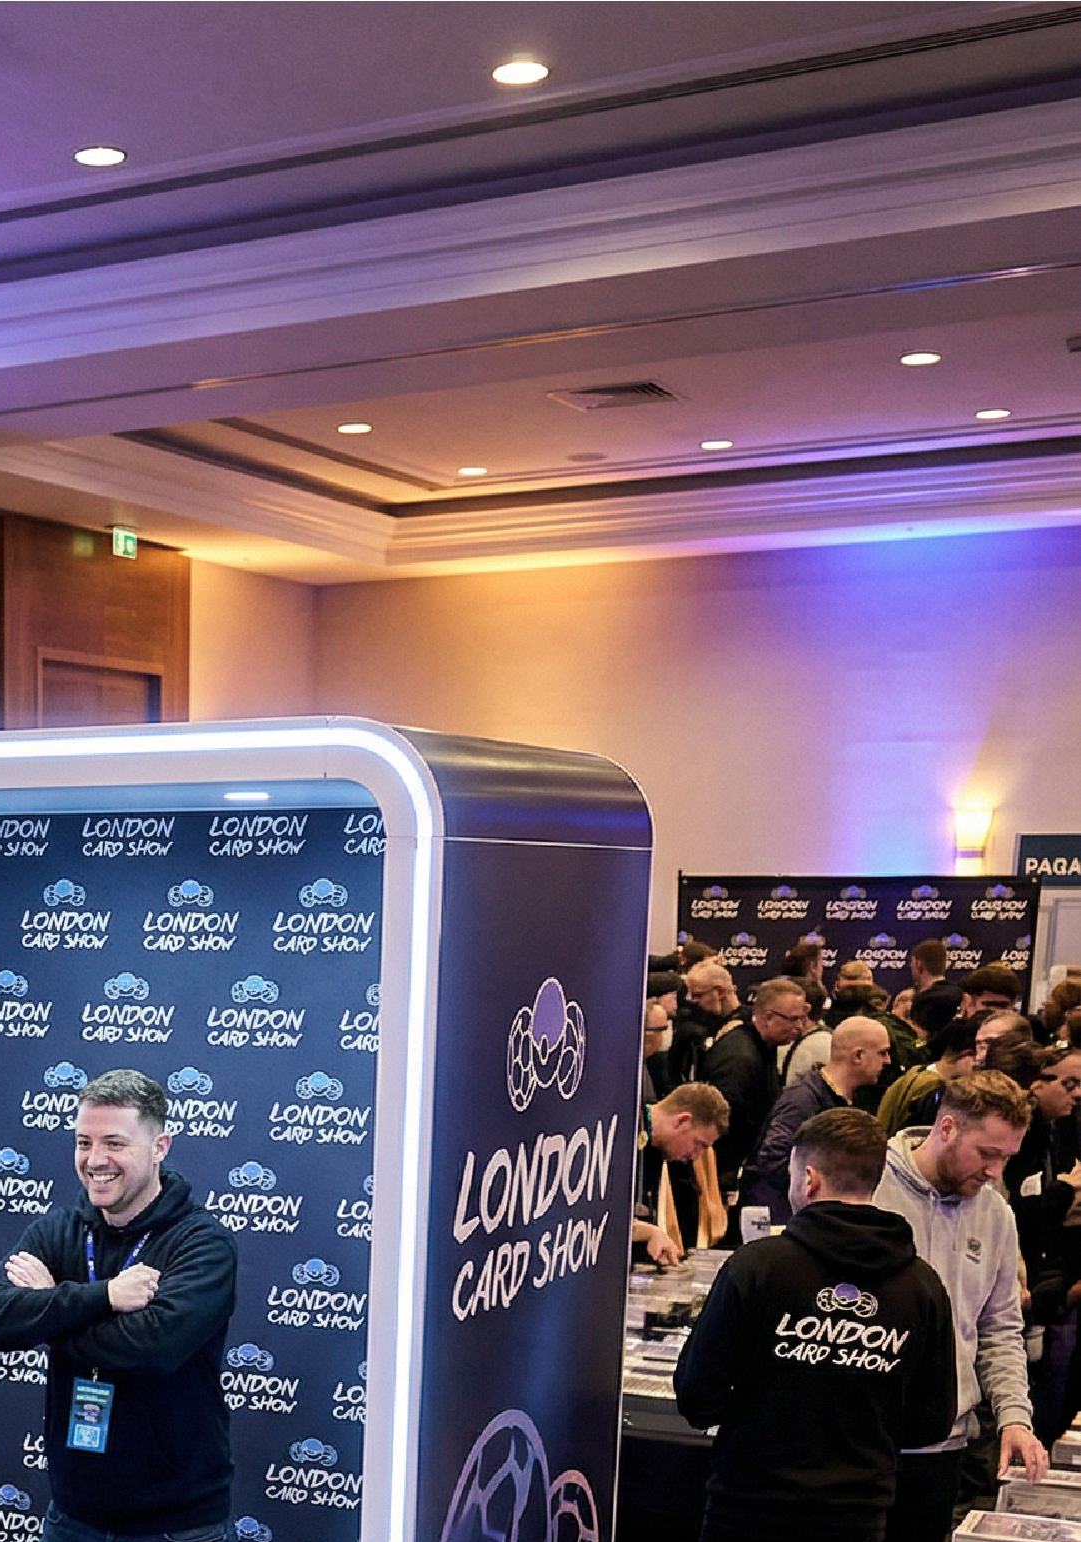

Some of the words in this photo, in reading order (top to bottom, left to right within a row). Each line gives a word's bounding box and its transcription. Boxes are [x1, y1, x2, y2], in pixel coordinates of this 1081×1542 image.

[82, 817, 175, 838] LONDON
[209, 815, 308, 837] LONDON
[7, 841, 49, 857] SHOW
[125, 840, 172, 857] SHOW
[256, 838, 305, 854] SHOW
[20, 911, 111, 932] LONDON
[143, 912, 240, 933] LONDON
[273, 912, 375, 934] LONDON
[63, 935, 109, 950] SHOW
[189, 936, 237, 952] SHOW
[321, 936, 371, 952] SHOW
[81, 1004, 175, 1027] LONDON
[207, 1008, 305, 1031] LONDON
[7, 1022, 49, 1038] SHOW
[125, 1028, 173, 1043] SHOW
[253, 1032, 302, 1047] SHOW
[21, 1091, 79, 1113] LOND
[165, 1099, 237, 1121] NDON
[268, 1103, 371, 1128] LONDON
[187, 1121, 234, 1138] SHOW
[317, 1128, 367, 1145] SHOW
[453, 1114, 617, 1244] LONDON
[205, 1191, 303, 1217] LONDON
[220, 1214, 248, 1232] ARD
[251, 1216, 300, 1233] SHOW
[337, 1223, 372, 1241] CAR
[452, 1241, 529, 1321] CARD
[533, 1211, 608, 1288] SHOW
[268, 1286, 367, 1315] LONDON
[268, 1310, 310, 1327] CARD
[313, 1313, 364, 1331] SHOW
[776, 1313, 910, 1354] LONDON
[775, 1341, 830, 1363] CARD
[832, 1349, 900, 1373] SHOW
[220, 1372, 299, 1397] ONDON
[248, 1396, 297, 1414] SHOW
[333, 1406, 366, 1423] CAR
[266, 1464, 363, 1494] LONDON
[311, 1491, 359, 1509] SHOW
